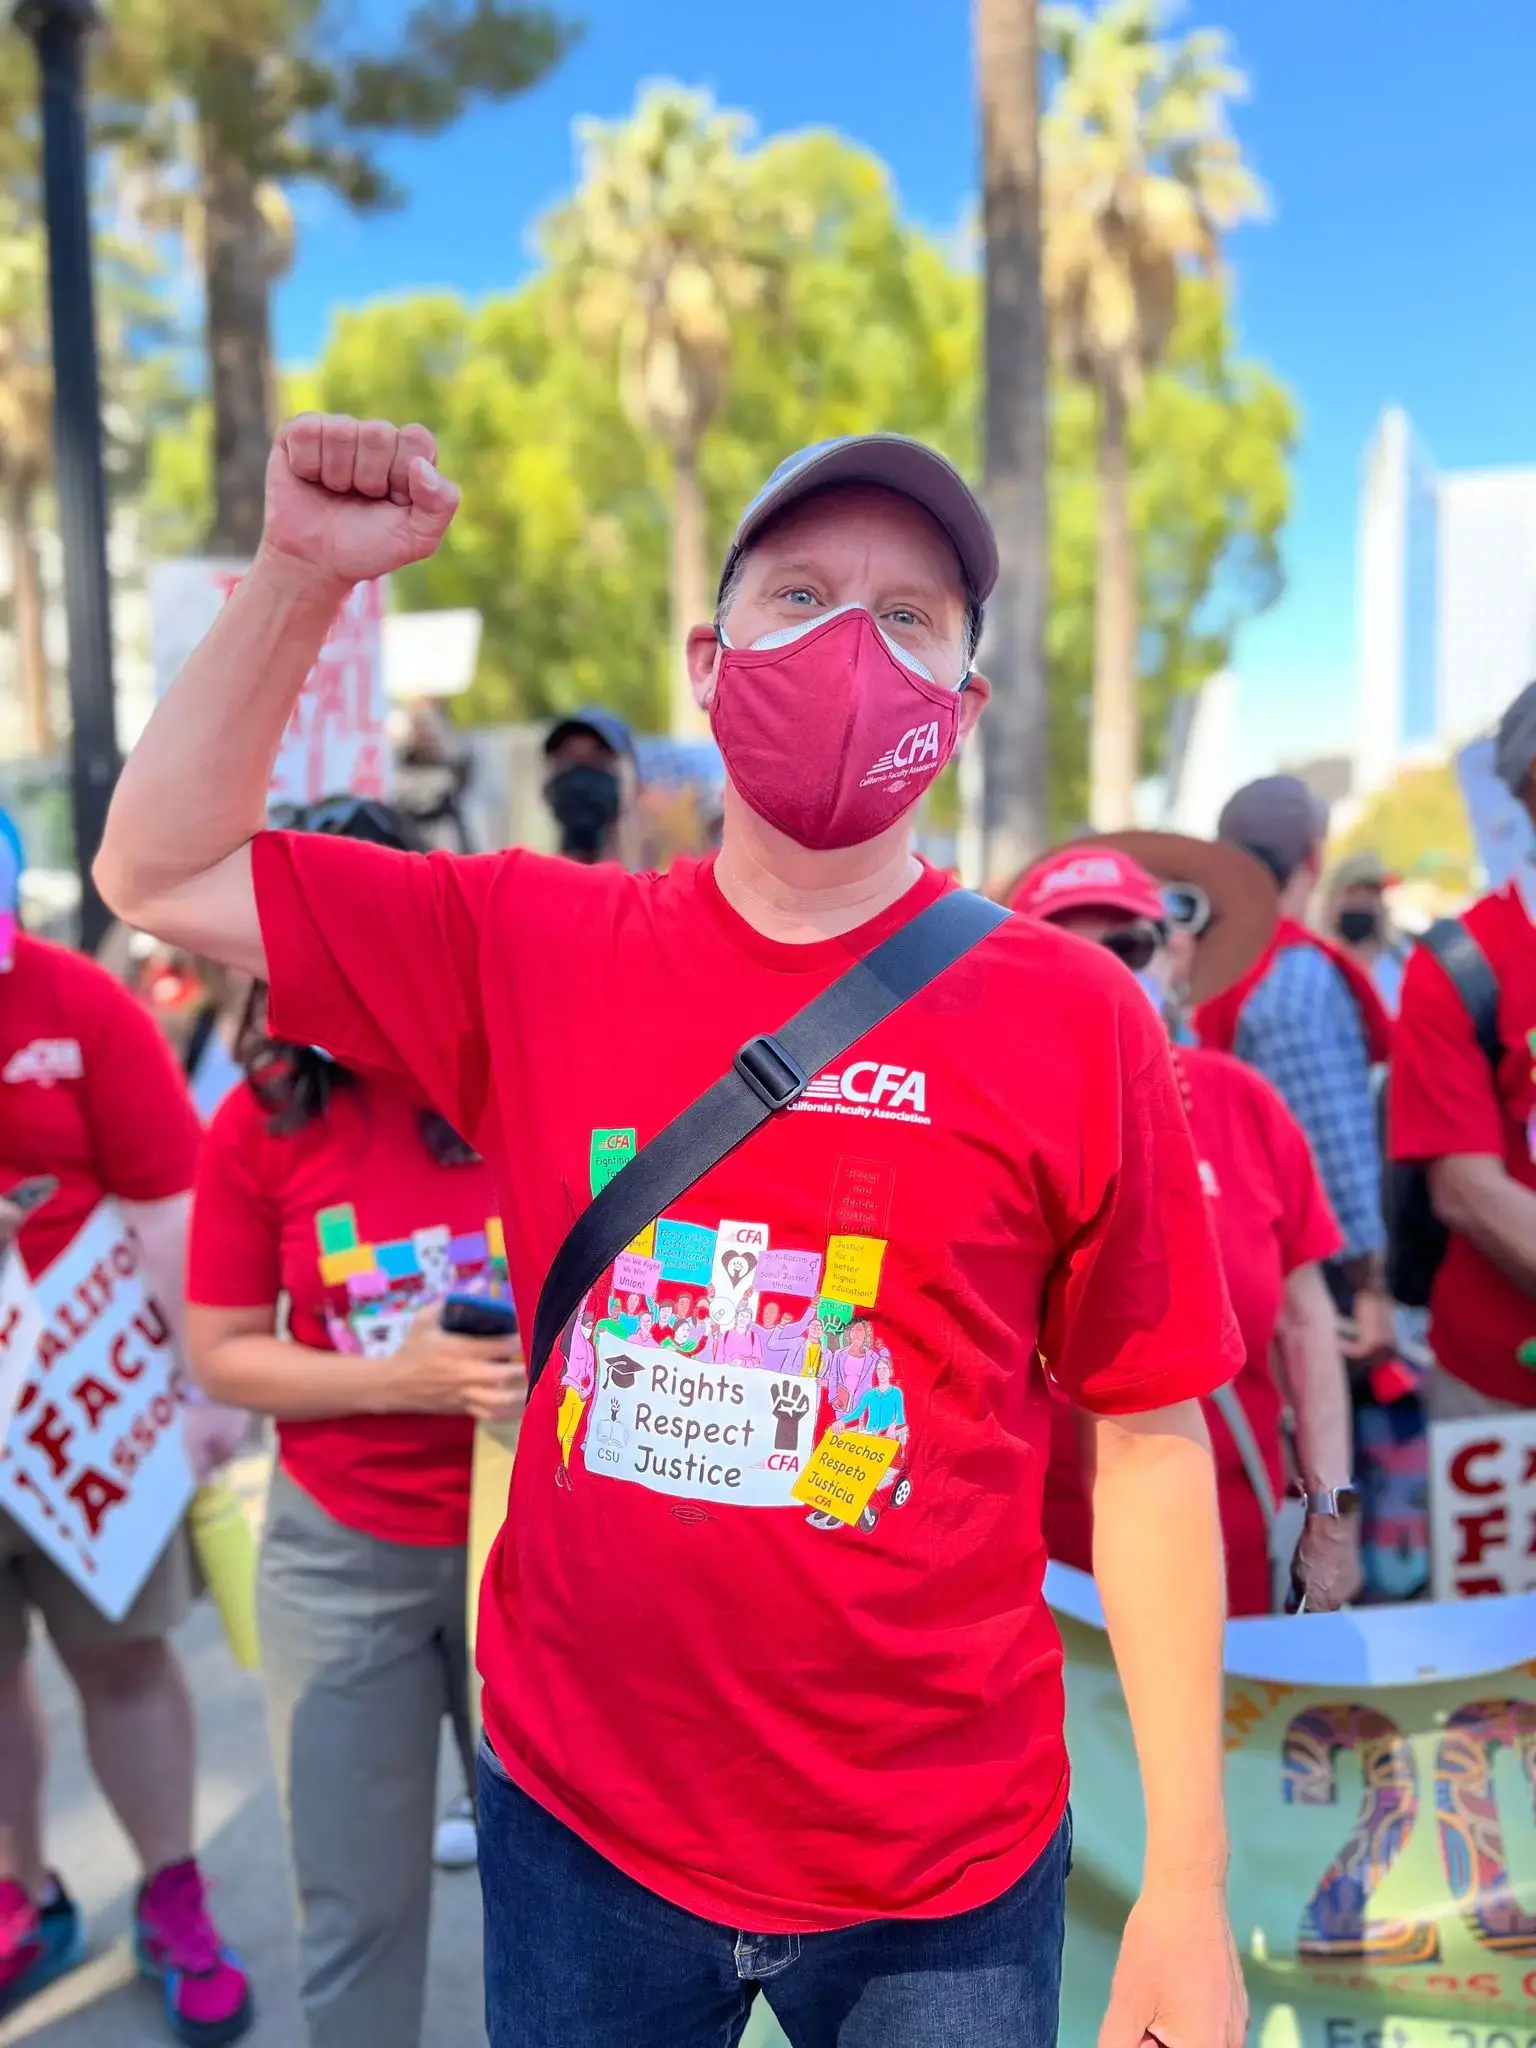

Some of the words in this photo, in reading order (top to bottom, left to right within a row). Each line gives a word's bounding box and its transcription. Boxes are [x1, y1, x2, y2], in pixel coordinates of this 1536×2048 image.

[893, 721, 938, 768] CFA
[888, 767, 908, 779] Faculty
[840, 1061, 926, 1112] CFA
[834, 1103, 871, 1118] Faculty
[872, 1108, 931, 1125] Association
[607, 1134, 630, 1149] CFA
[736, 1229, 762, 1245] CFA
[619, 1275, 646, 1290] Union!
[820, 1301, 850, 1312] STRIKE!
[652, 1365, 744, 1407] Rights
[635, 1403, 755, 1448] Respect
[597, 1448, 620, 1463] CSU
[829, 1435, 886, 1463] Derechos
[634, 1445, 741, 1487] Justice
[767, 1454, 799, 1472] CFA
[819, 1452, 866, 1482] Respeto
[808, 1471, 854, 1505] Justicia
[814, 1495, 832, 1508] CFA
